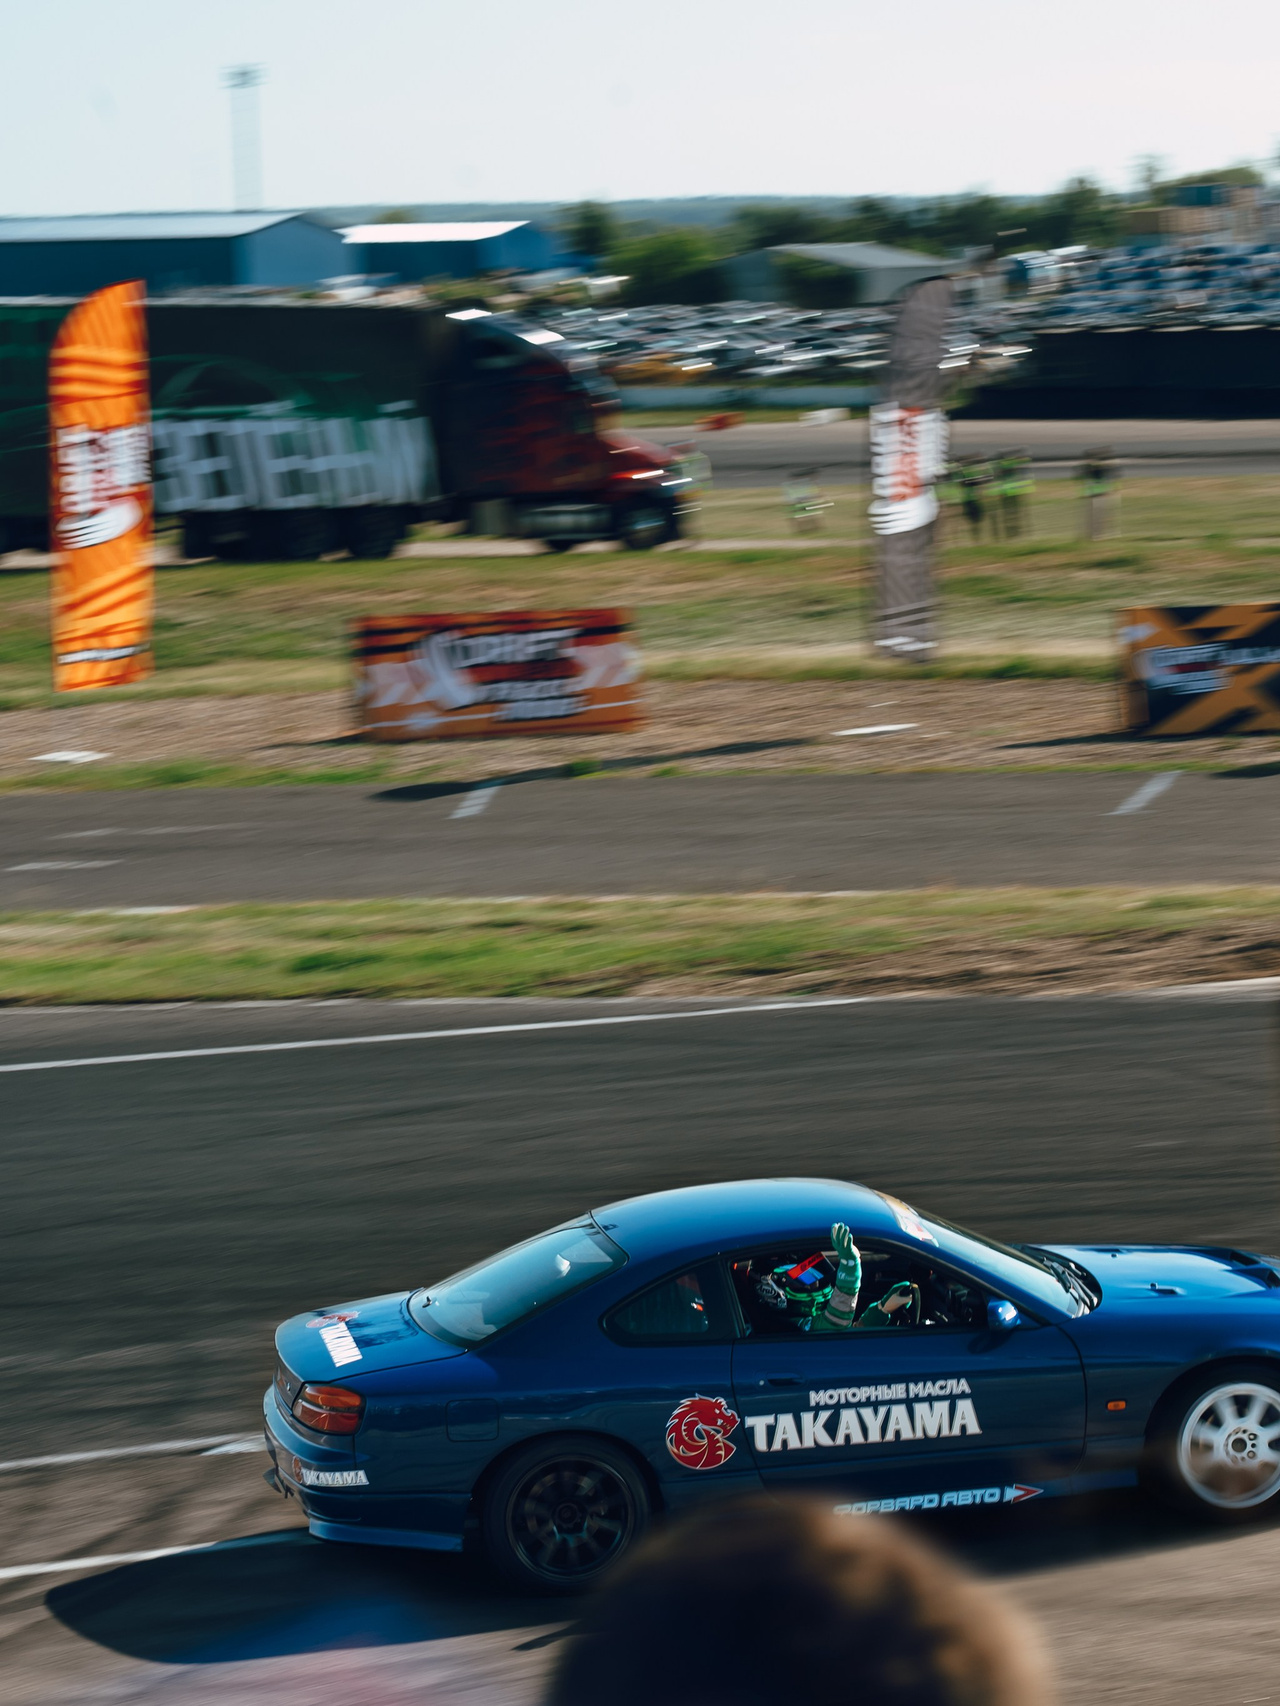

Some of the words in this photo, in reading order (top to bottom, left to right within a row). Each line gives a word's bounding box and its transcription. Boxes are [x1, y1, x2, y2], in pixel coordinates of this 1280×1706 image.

[809, 1383, 907, 1407] МОТОРНЫЕ
[909, 1378, 972, 1400] МАСЛА
[745, 1398, 983, 1452] TAKAYAMA
[941, 1487, 1002, 1508] АВТО
